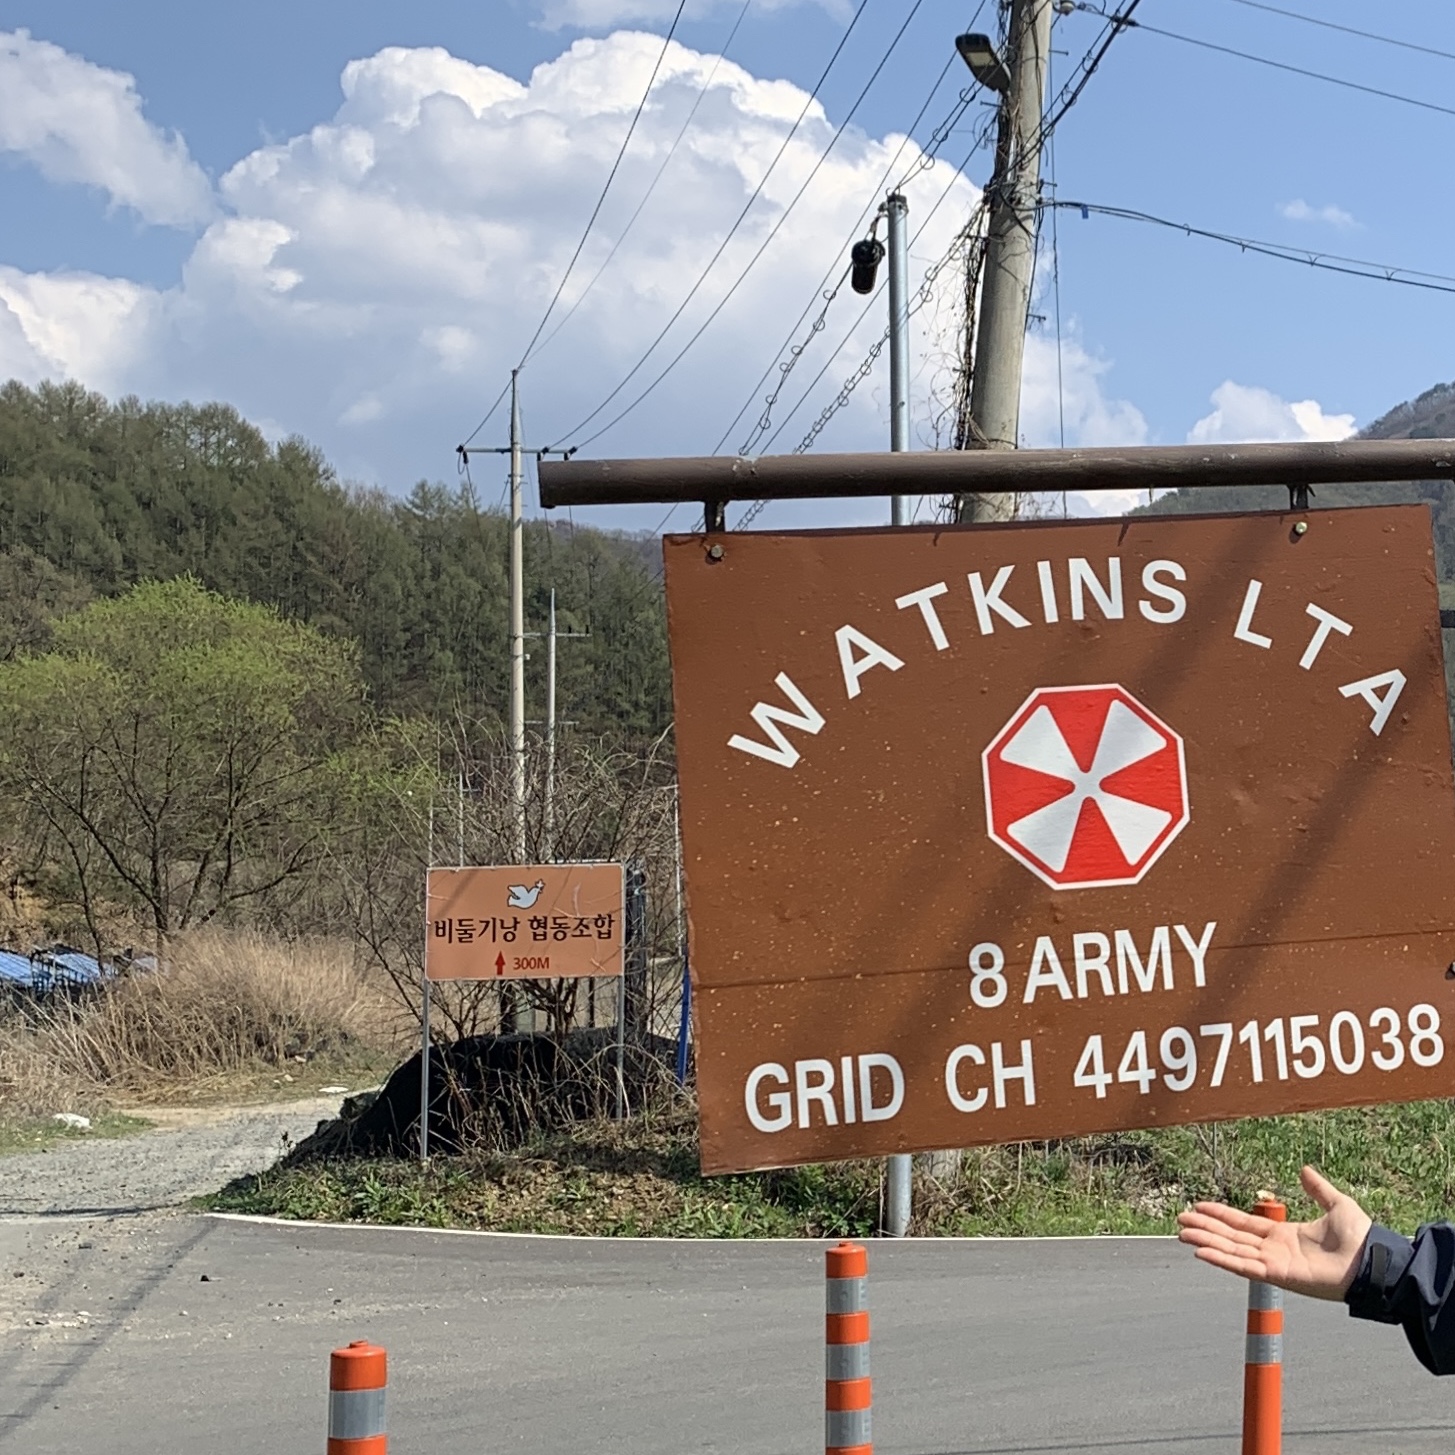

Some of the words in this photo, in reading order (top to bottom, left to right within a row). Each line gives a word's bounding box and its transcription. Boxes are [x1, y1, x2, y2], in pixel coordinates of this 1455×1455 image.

[728, 557, 1187, 770] WATKINS
[1233, 579, 1407, 736] LTA
[434, 916, 521, 944] 비둘기낭
[528, 914, 616, 942] 협동조합
[513, 956, 550, 971] 300M
[968, 942, 1008, 1008] 8
[1022, 921, 1217, 1004] ARMY
[744, 1053, 905, 1133] GRID
[945, 1039, 1036, 1113] CH
[1073, 1003, 1444, 1099] 4497115038
